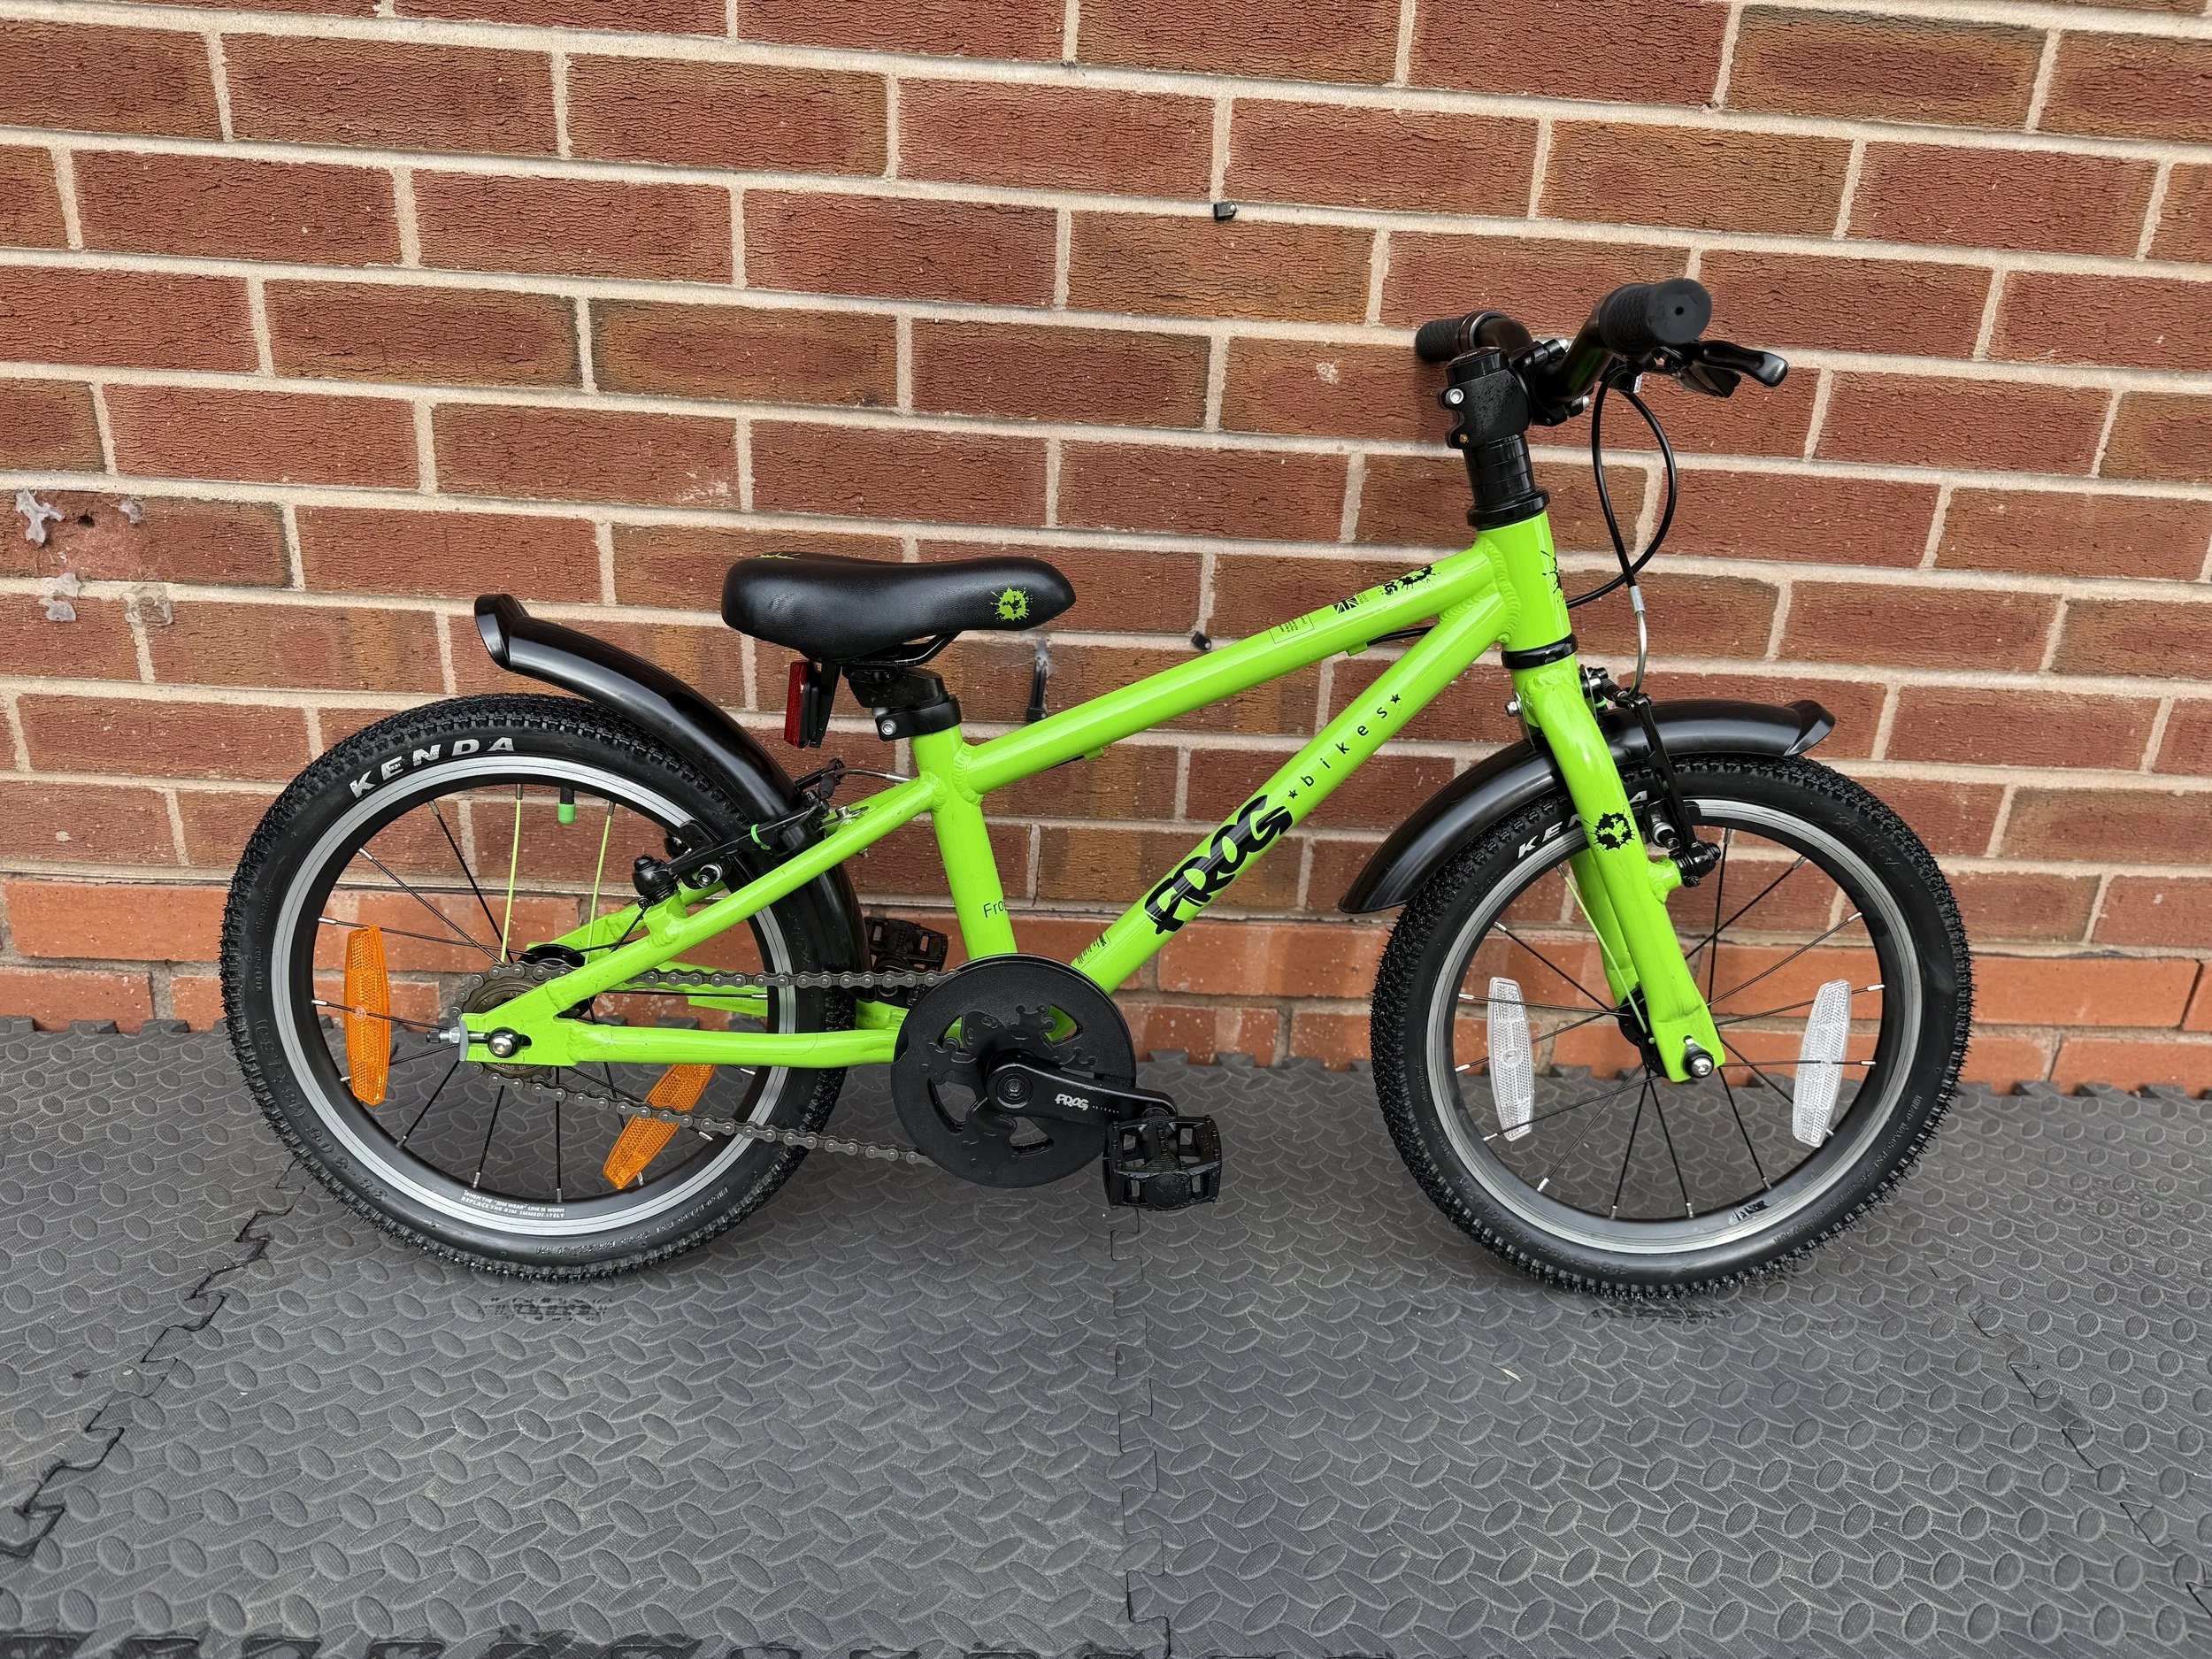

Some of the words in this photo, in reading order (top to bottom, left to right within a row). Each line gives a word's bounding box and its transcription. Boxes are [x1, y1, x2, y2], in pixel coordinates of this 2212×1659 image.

[1300, 706, 1388, 787] bikes
[349, 736, 515, 799] KENDA
[1143, 795, 1294, 935] FROG
[1055, 1093, 1089, 1111] FROG
[460, 1196, 490, 1210] REPLACE
[489, 1203, 503, 1212] THE
[463, 1190, 482, 1202] WHEN
